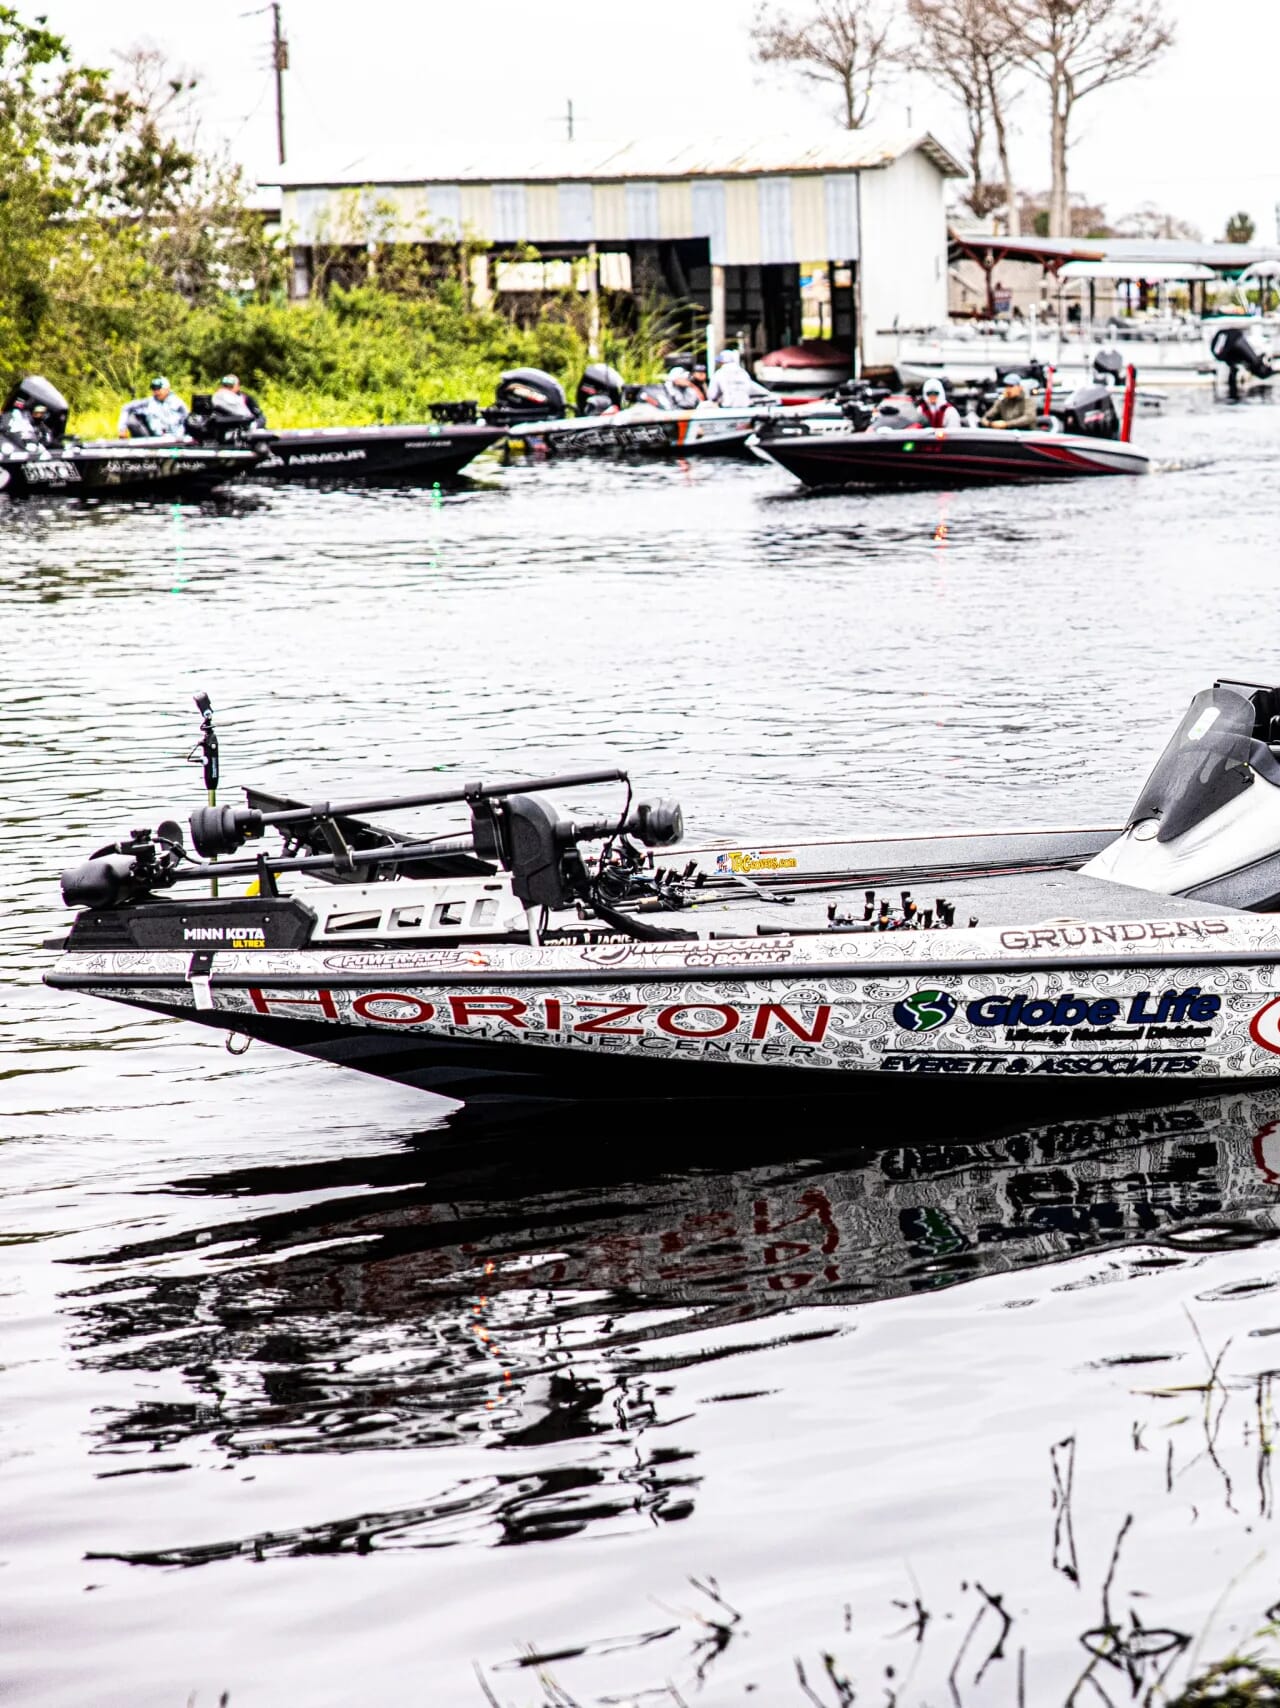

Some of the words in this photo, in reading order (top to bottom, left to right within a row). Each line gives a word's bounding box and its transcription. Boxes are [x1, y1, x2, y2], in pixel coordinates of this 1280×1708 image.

[288, 450, 367, 465] ARMOUR
[184, 928, 224, 940] MINN
[225, 928, 265, 940] KOTA
[232, 940, 265, 948] ULTREX
[686, 953, 713, 965] GO
[966, 994, 1121, 1027] Globe
[1126, 987, 1223, 1024] Life
[248, 988, 831, 1043] HORIZON
[448, 1026, 630, 1046] MARINE
[649, 1037, 817, 1058] CENTER
[880, 1056, 1008, 1074] EVERETT
[1007, 1057, 1032, 1074] &
[1032, 1056, 1202, 1074] ASSOCIATES
